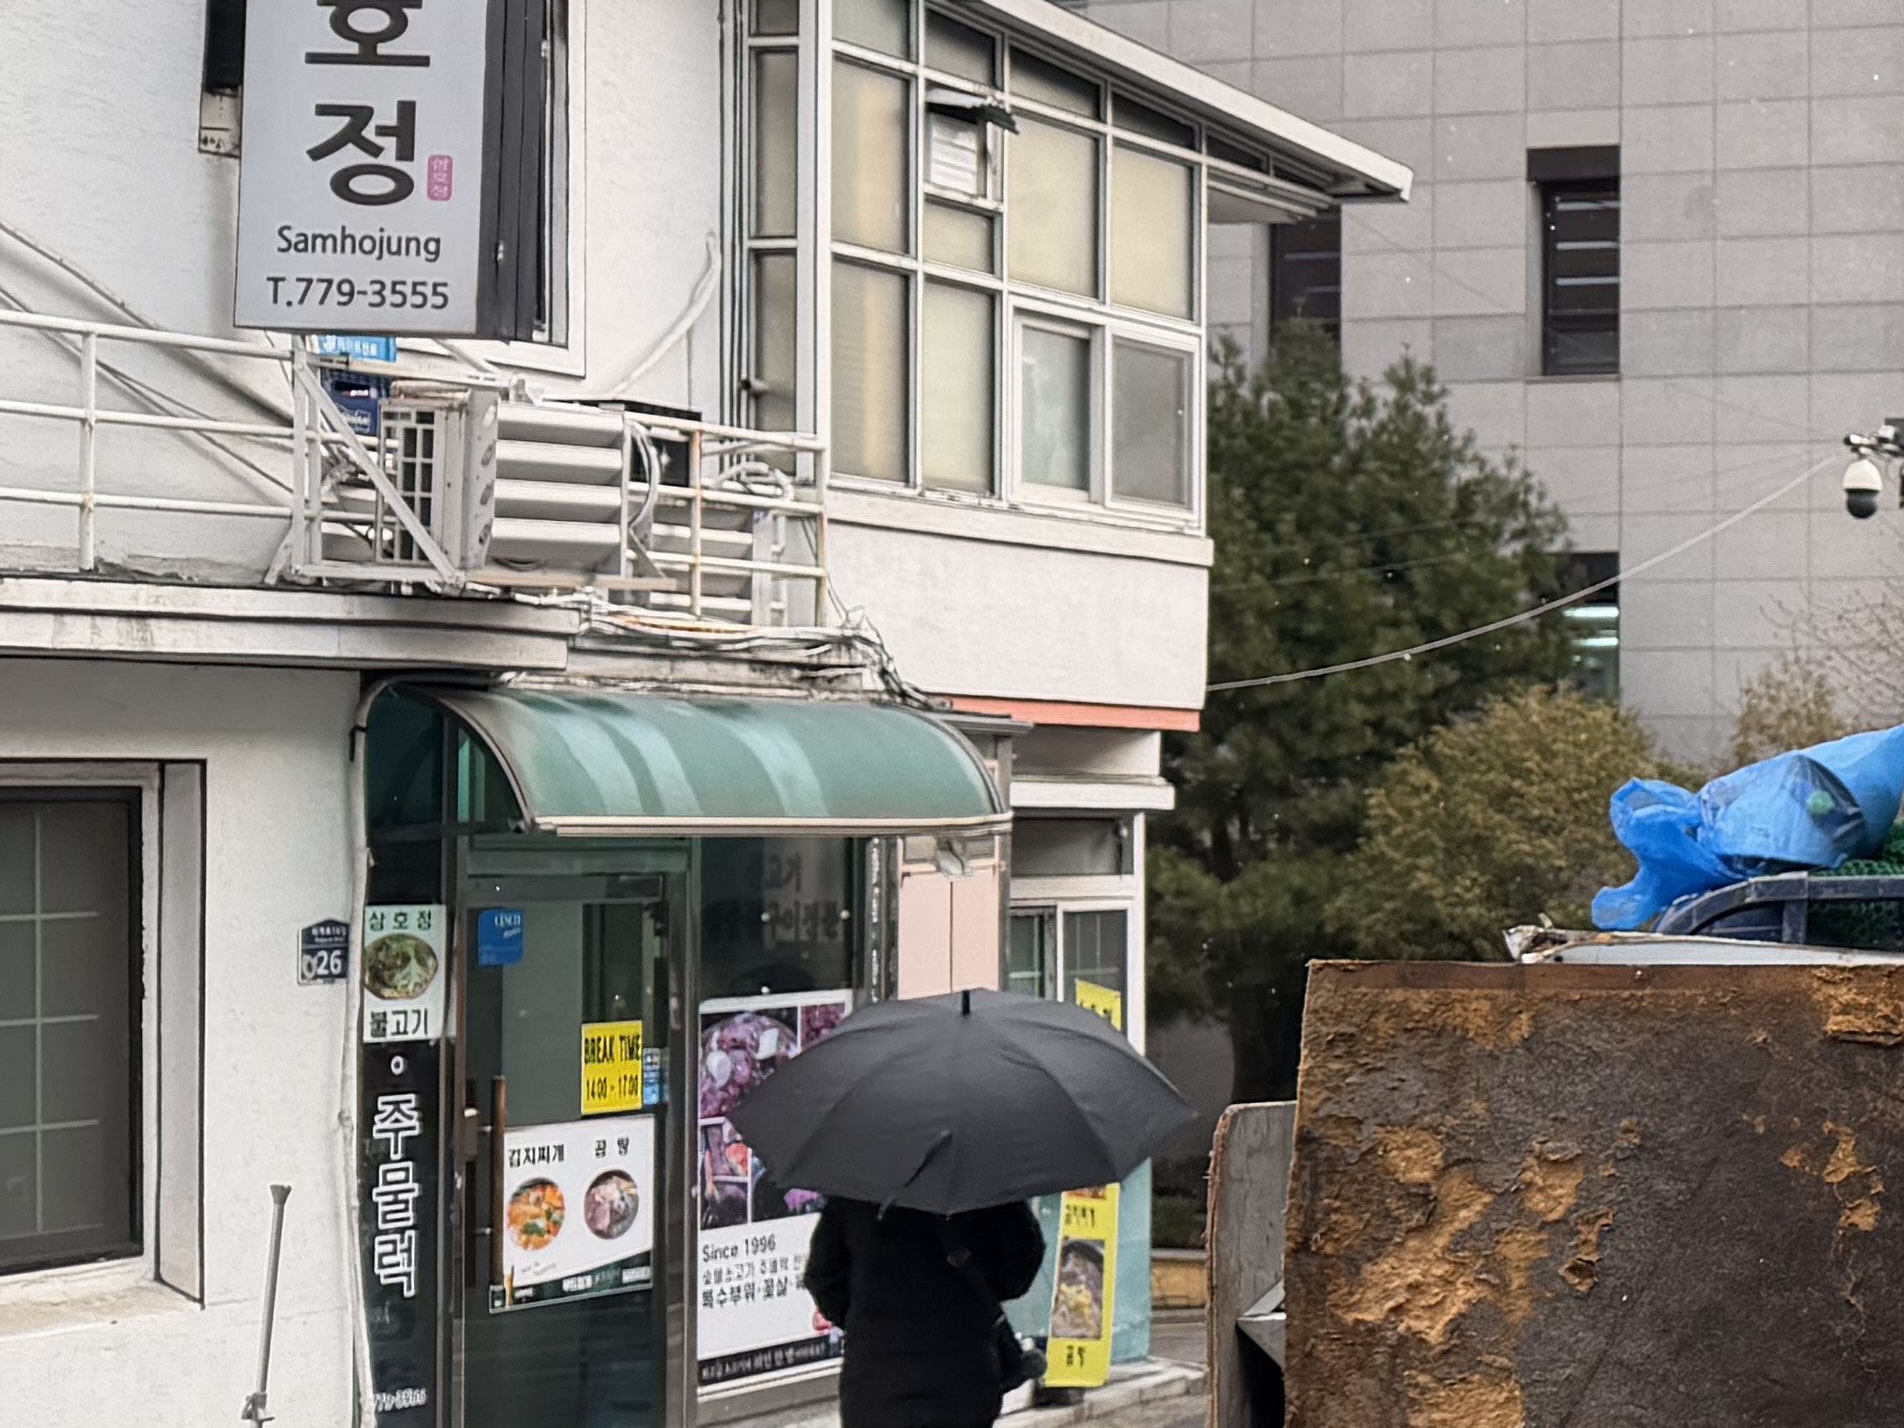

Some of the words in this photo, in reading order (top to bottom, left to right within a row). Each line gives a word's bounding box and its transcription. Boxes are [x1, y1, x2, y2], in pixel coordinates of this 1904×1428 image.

[277, 225, 441, 262] Samhojung
[266, 276, 449, 310] T.779-3555
[369, 909, 431, 931] 삼호정
[370, 1007, 428, 1038] 불고기
[584, 1035, 615, 1065] BREAK
[619, 1031, 641, 1063] TIME
[508, 1144, 565, 1168] 김치찌개
[372, 1093, 419, 1298] 주물럭
[702, 1244, 738, 1263] Since
[745, 1233, 776, 1256] 1996
